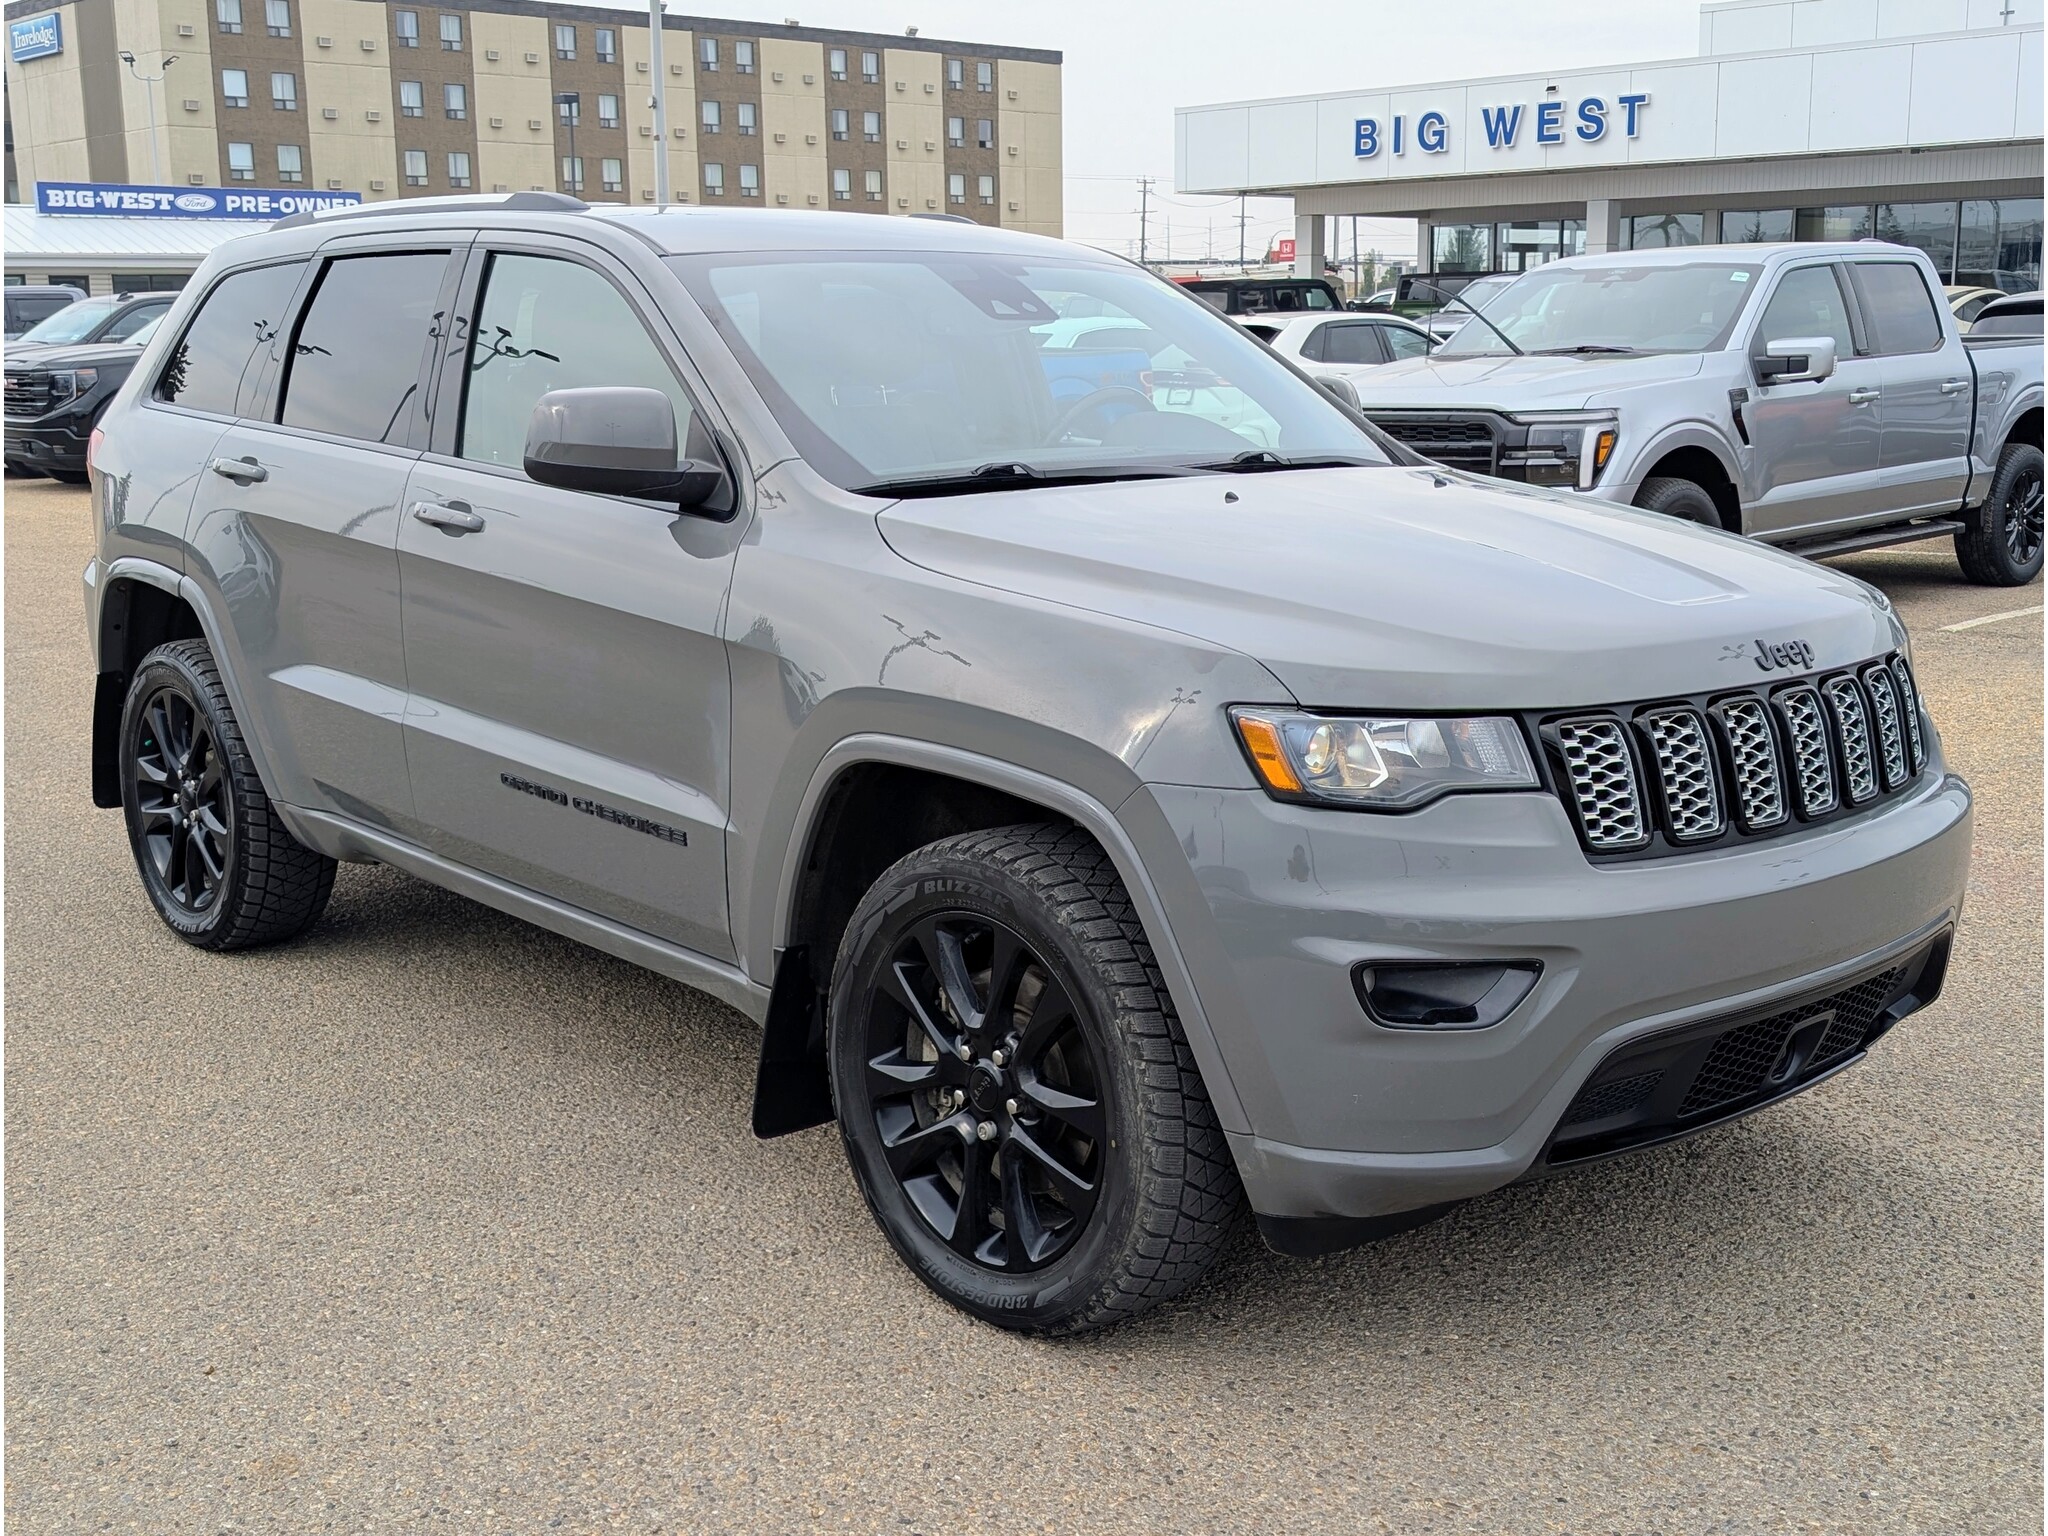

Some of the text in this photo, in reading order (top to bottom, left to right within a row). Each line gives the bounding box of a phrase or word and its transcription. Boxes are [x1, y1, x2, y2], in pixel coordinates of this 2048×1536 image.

[13, 26, 54, 48] Travelodge
[1354, 92, 1652, 159] BIG WEST
[46, 190, 96, 208] BIG
[99, 191, 175, 211] WEST
[1753, 639, 1815, 671] Jeep
[500, 772, 688, 847] GRAND CHEROKEE
[924, 879, 1010, 909] BLIZZAK
[918, 1256, 1030, 1309] BRIDGESTONE
